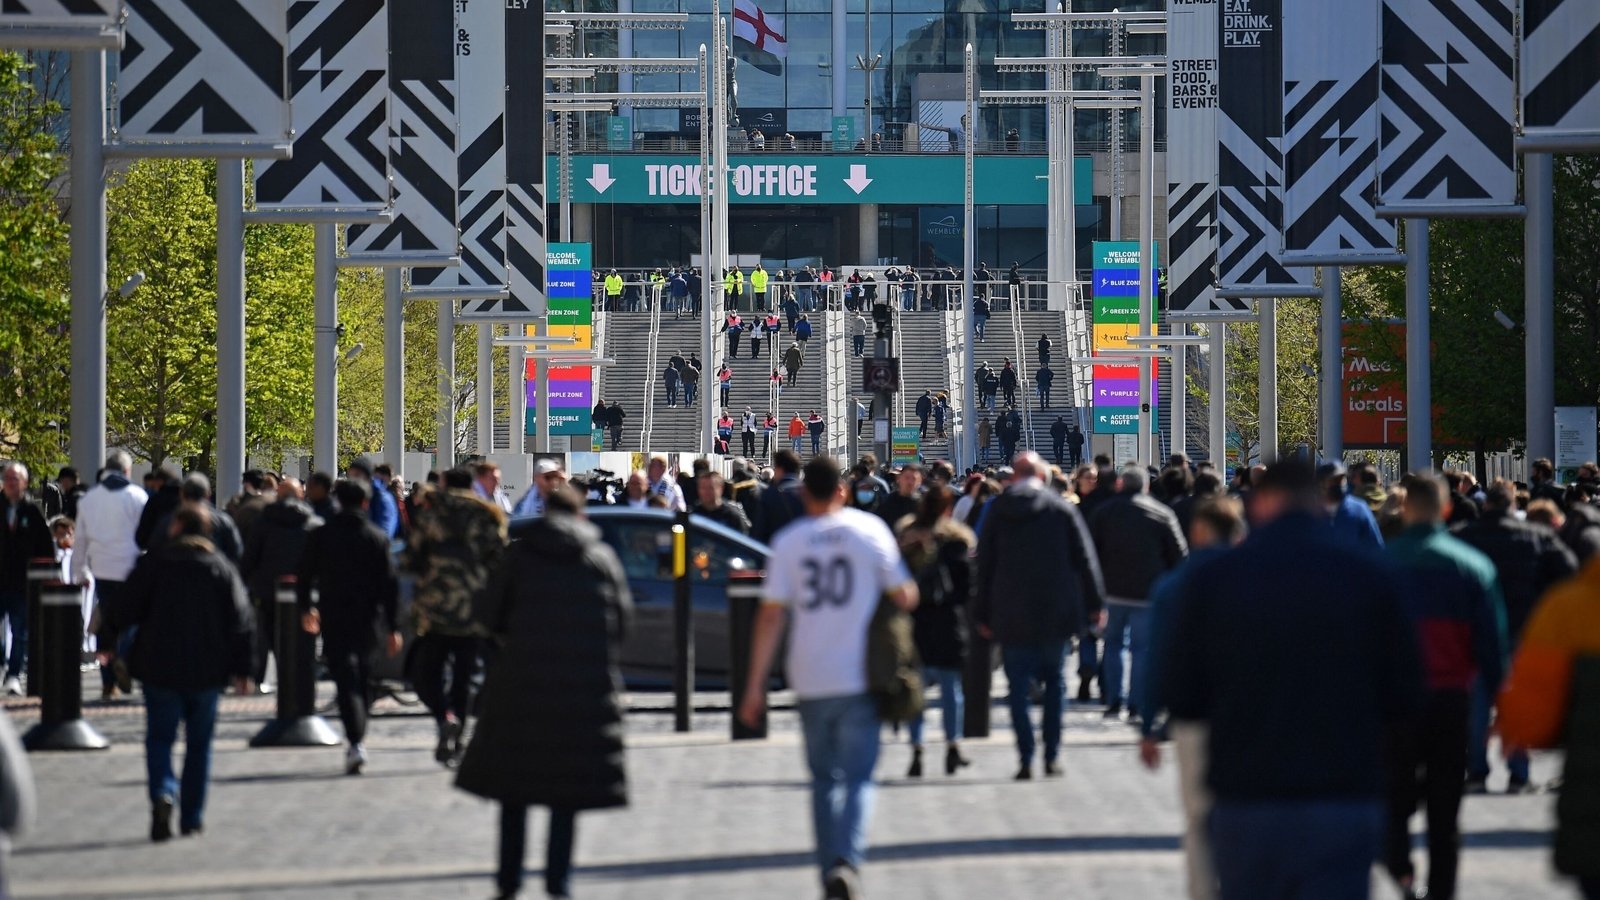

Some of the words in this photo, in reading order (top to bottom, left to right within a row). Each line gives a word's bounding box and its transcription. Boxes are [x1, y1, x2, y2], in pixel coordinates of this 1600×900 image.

[1223, 0, 1252, 12] EAT.
[1223, 15, 1273, 28] DRINK.
[458, 28, 470, 42] &
[1223, 32, 1261, 45] PLAY.
[1172, 72, 1211, 85] FOOD,
[1172, 85, 1207, 97] BARS
[735, 164, 817, 196] OFFICE
[1348, 356, 1392, 372] Mee
[1110, 390, 1133, 398] PURPLE
[800, 555, 854, 610] 30
